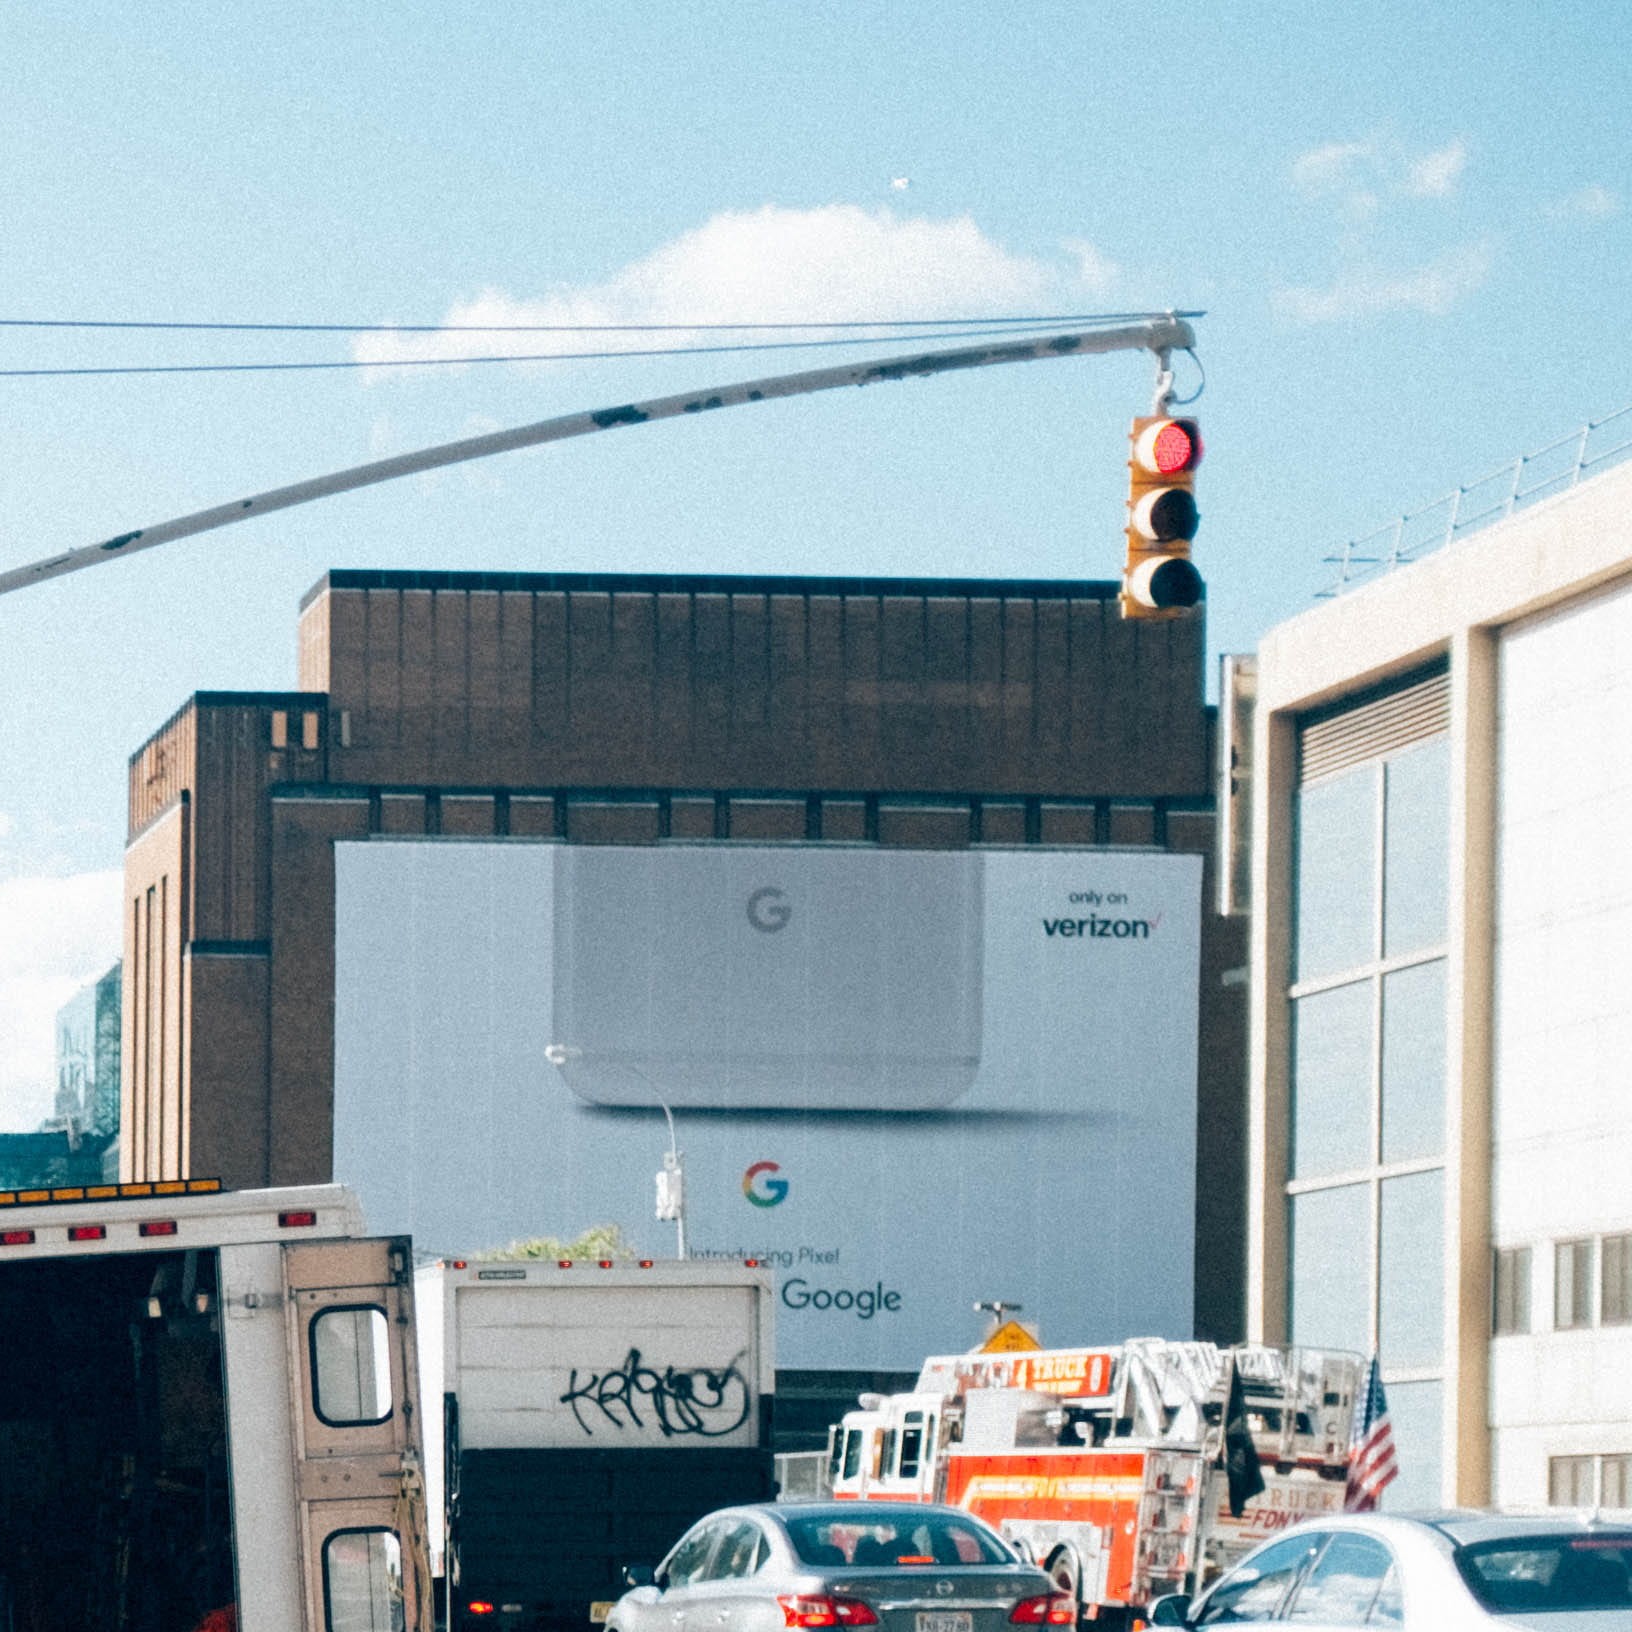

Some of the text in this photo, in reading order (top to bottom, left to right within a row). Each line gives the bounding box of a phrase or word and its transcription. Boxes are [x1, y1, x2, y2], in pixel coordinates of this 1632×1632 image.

[1069, 890, 1128, 907] only on
[1043, 913, 1149, 938] verizon
[799, 1247, 839, 1265] Pixel
[782, 1278, 901, 1320] Google
[1032, 1356, 1087, 1379] TRUCK
